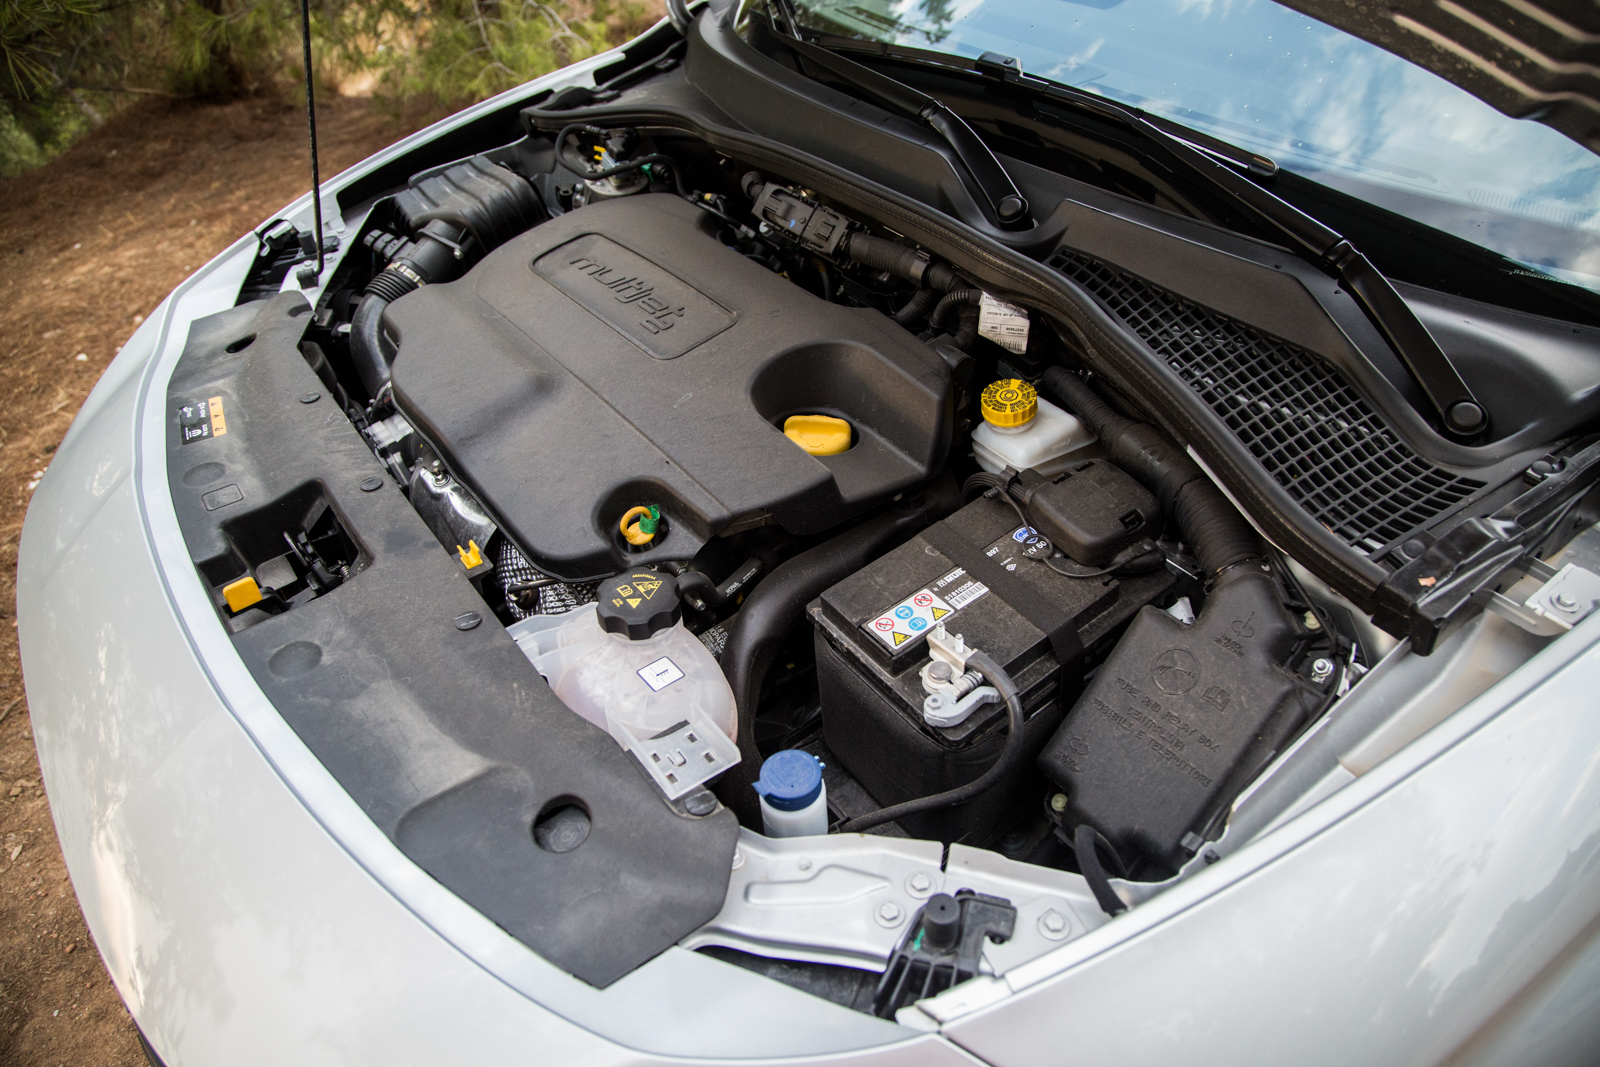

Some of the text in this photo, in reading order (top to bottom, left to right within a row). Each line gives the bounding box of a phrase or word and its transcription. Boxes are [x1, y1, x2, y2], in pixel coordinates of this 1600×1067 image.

[569, 258, 685, 318] multijet
[986, 547, 1000, 558] 897
[1036, 540, 1048, 550] 60
[1090, 697, 1135, 732] FUSIBILI
[1114, 677, 1222, 754] FUSE AND RELAY BOX
[1126, 706, 1186, 751] CENTRALINA
